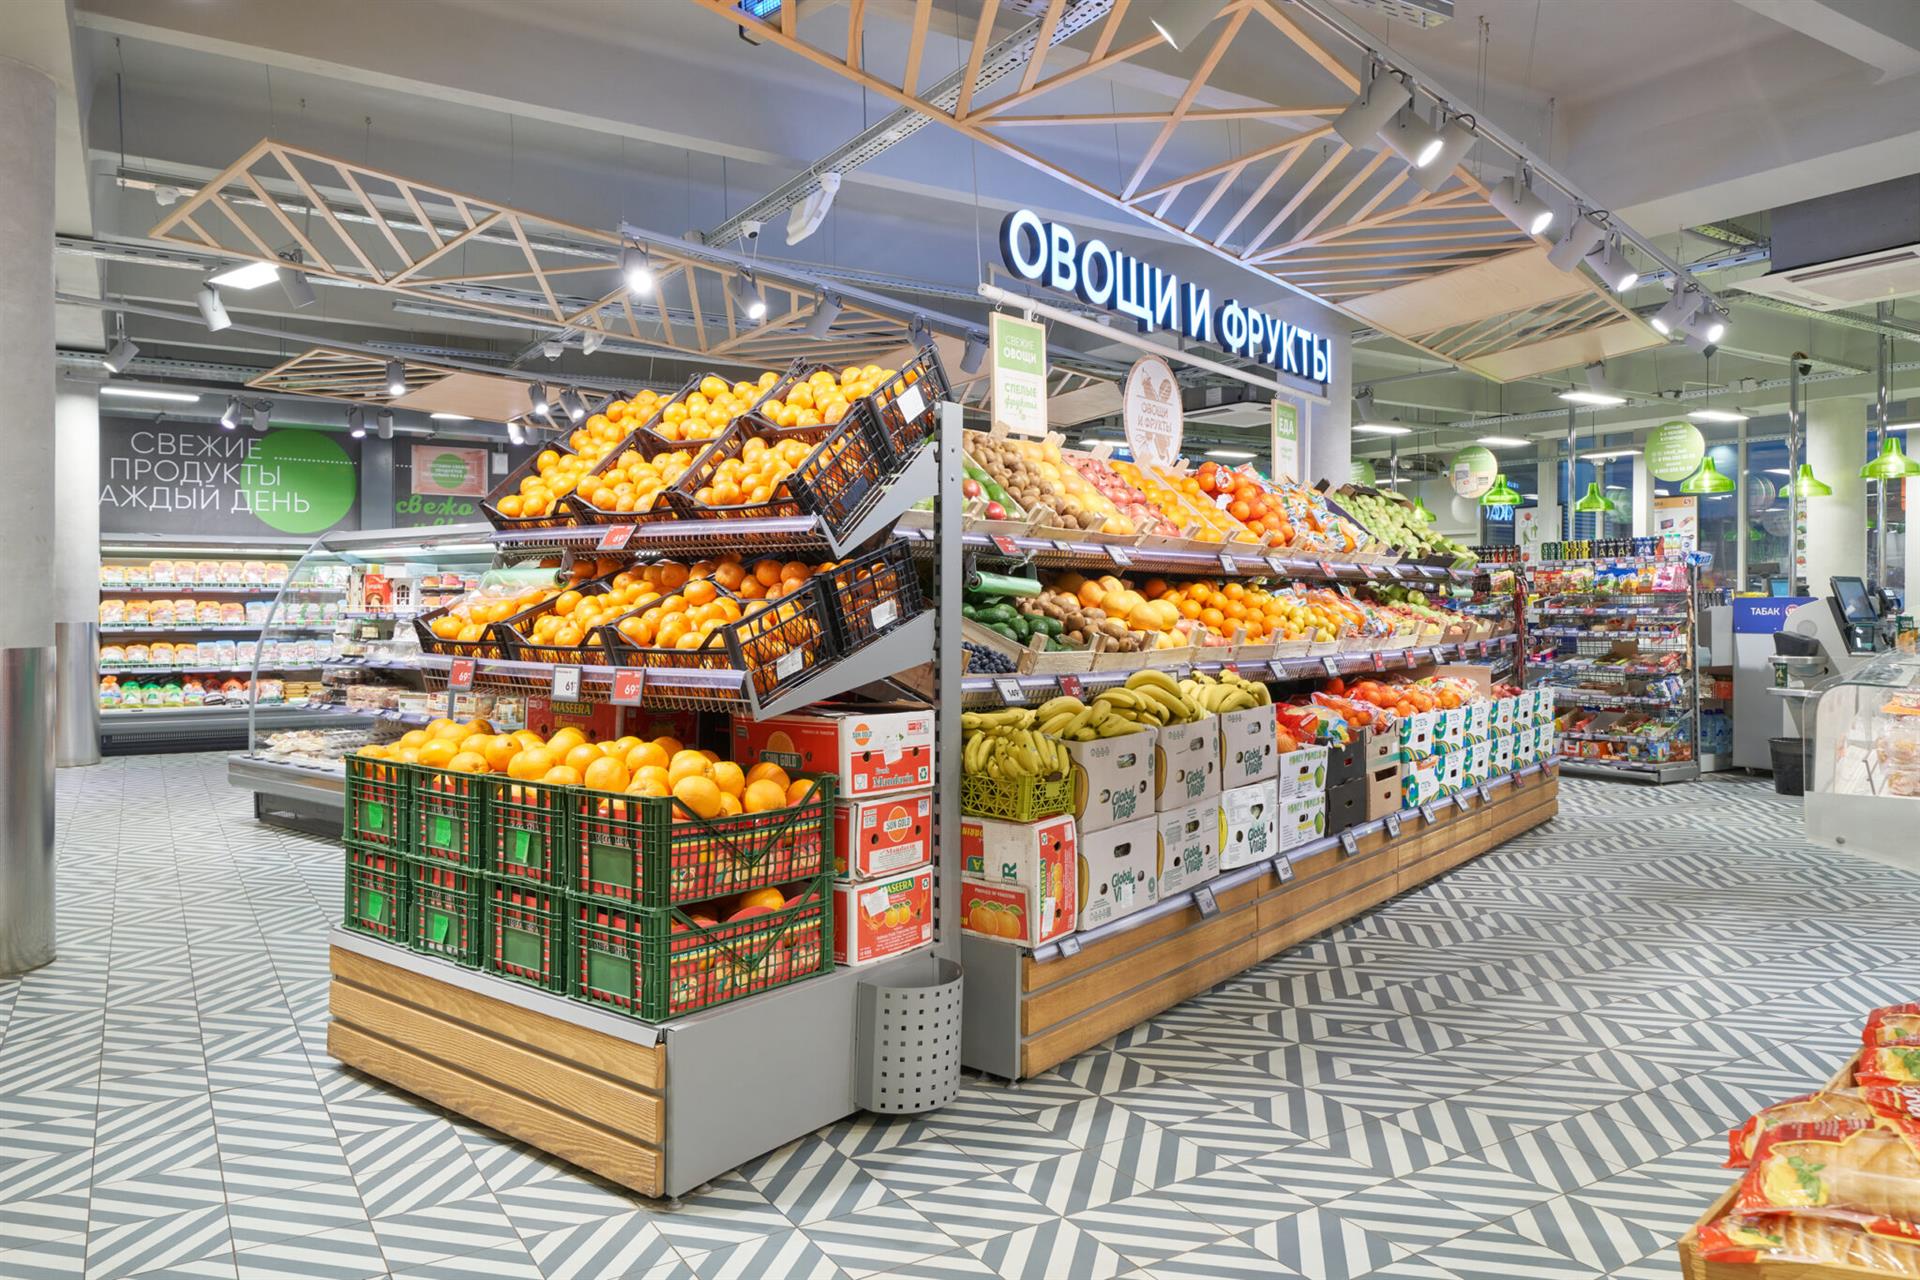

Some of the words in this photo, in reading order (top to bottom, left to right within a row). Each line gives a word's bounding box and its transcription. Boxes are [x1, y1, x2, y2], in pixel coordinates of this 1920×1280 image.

[1004, 209, 1178, 333] ОВОЩИ
[1188, 282, 1211, 342] И
[1220, 299, 1332, 384] ФРУКТЫ
[1003, 346, 1037, 365] ОВОЩИ
[1004, 382, 1037, 398] СПЕЛЫЕ
[1141, 402, 1169, 418] ОВОЩИ
[1137, 414, 1143, 427] И
[1145, 417, 1172, 433] ФРУКТЫ
[1279, 416, 1294, 435] ЕДА
[130, 431, 263, 460] СВЕЖИЕ
[110, 457, 281, 487] ПРОДУКТЫ
[98, 483, 221, 513] АЖДЫЙ
[230, 488, 311, 515] ДЕНЬ
[395, 494, 475, 516] свежо
[1750, 607, 1781, 616] ТАБАК
[779, 754, 797, 768] GOLD
[1244, 746, 1262, 764] Global
[1186, 766, 1205, 785] Global
[1245, 760, 1263, 776] Village
[1111, 785, 1137, 806] Global
[1187, 780, 1205, 799] Village
[1112, 800, 1137, 821] Village
[886, 820, 897, 831] SUN
[897, 817, 911, 827] GOLD
[1248, 822, 1267, 841] Global
[1183, 842, 1203, 861] Global
[1249, 838, 1268, 855] Village
[1184, 857, 1203, 875] Village
[1111, 867, 1136, 888] Global
